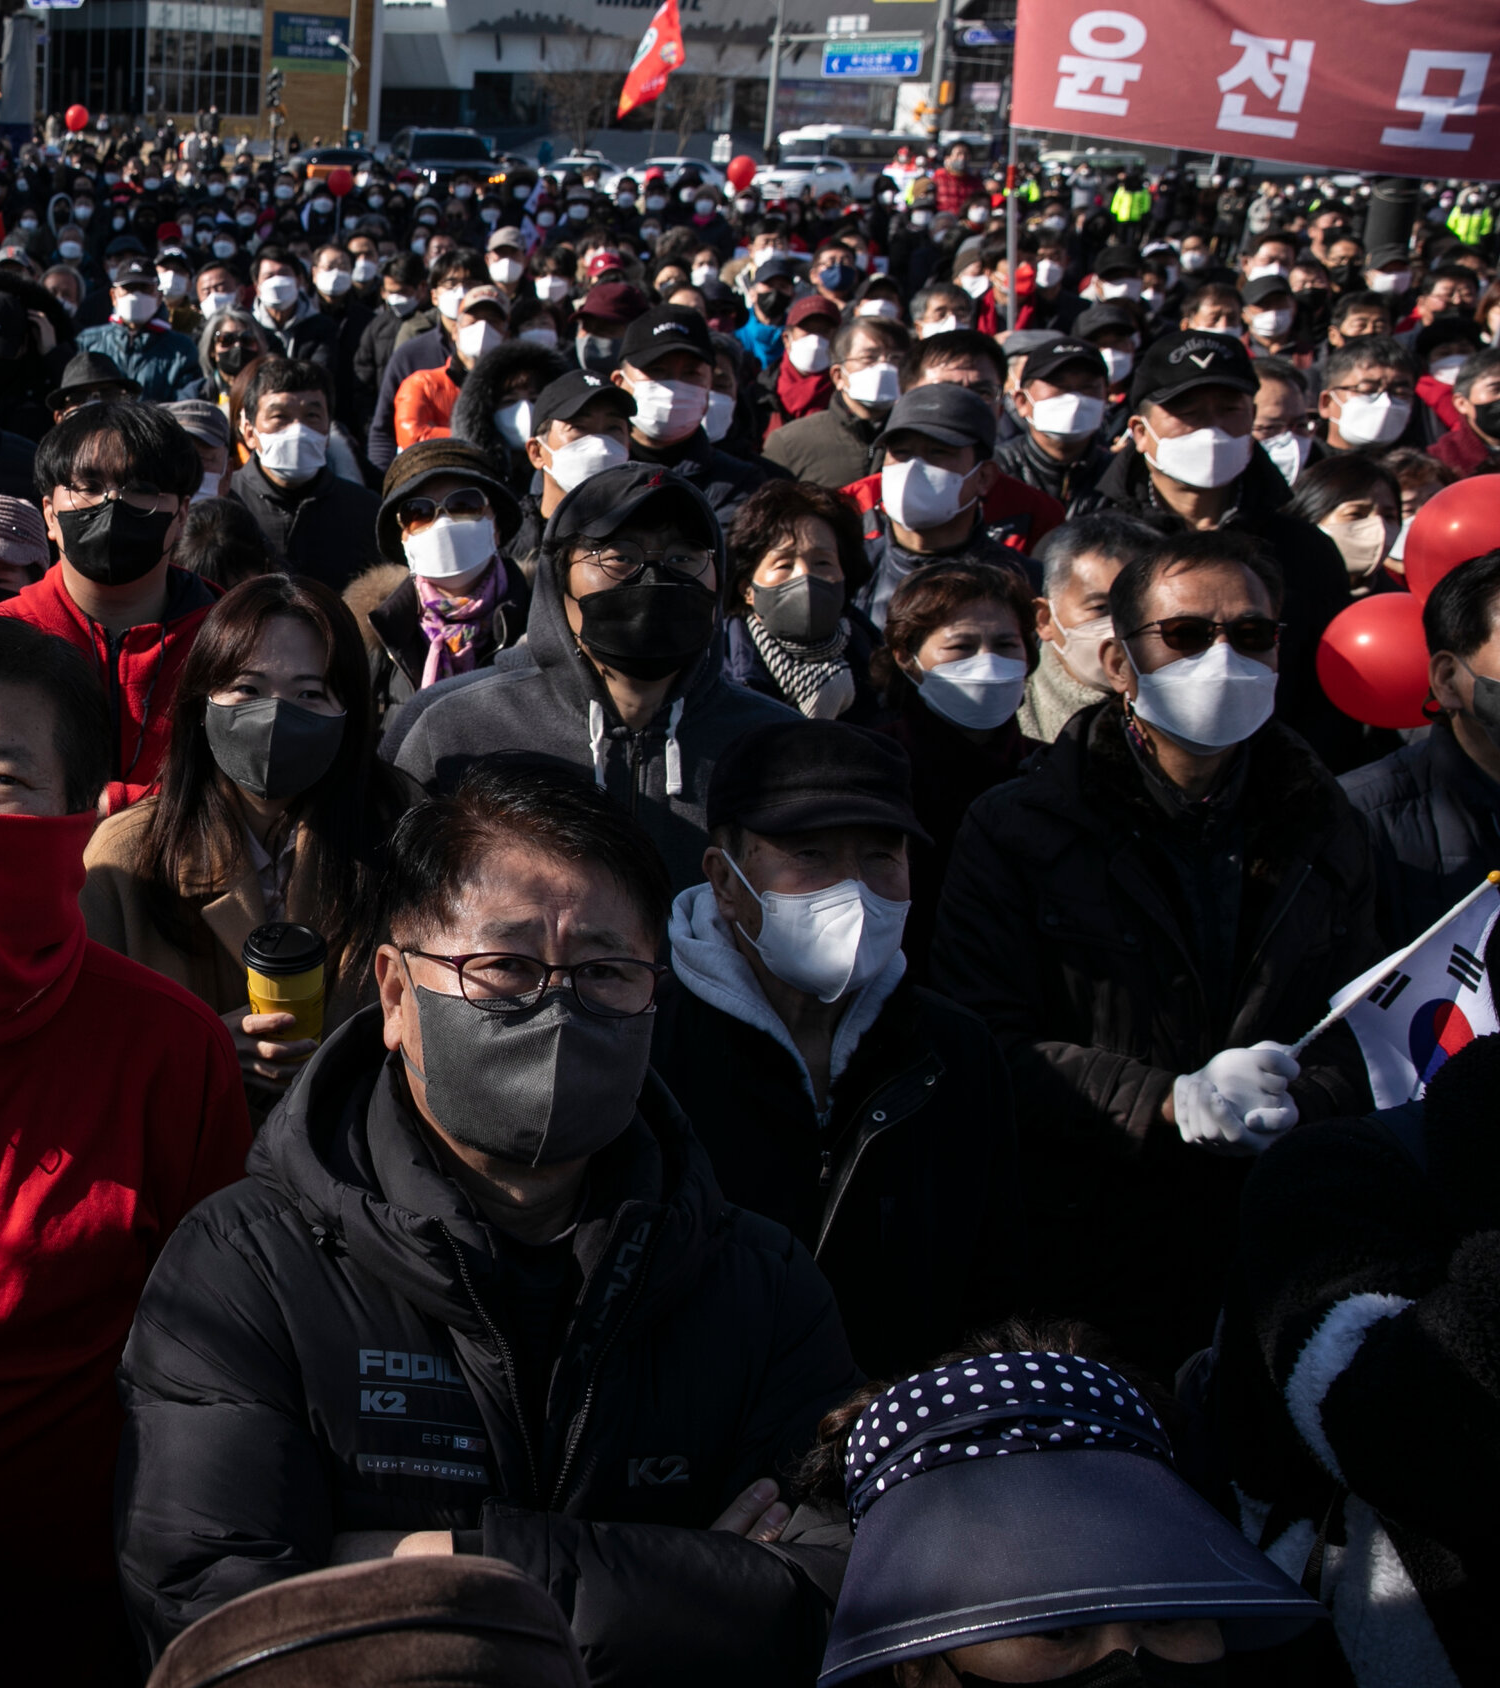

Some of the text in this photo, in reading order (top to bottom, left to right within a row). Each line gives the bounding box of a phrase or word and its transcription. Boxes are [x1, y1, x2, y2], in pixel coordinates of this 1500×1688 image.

[360, 1389, 407, 1414] K2
[366, 1460, 483, 1479] LIGHT MOVEMENT
[627, 1455, 691, 1488] K2
